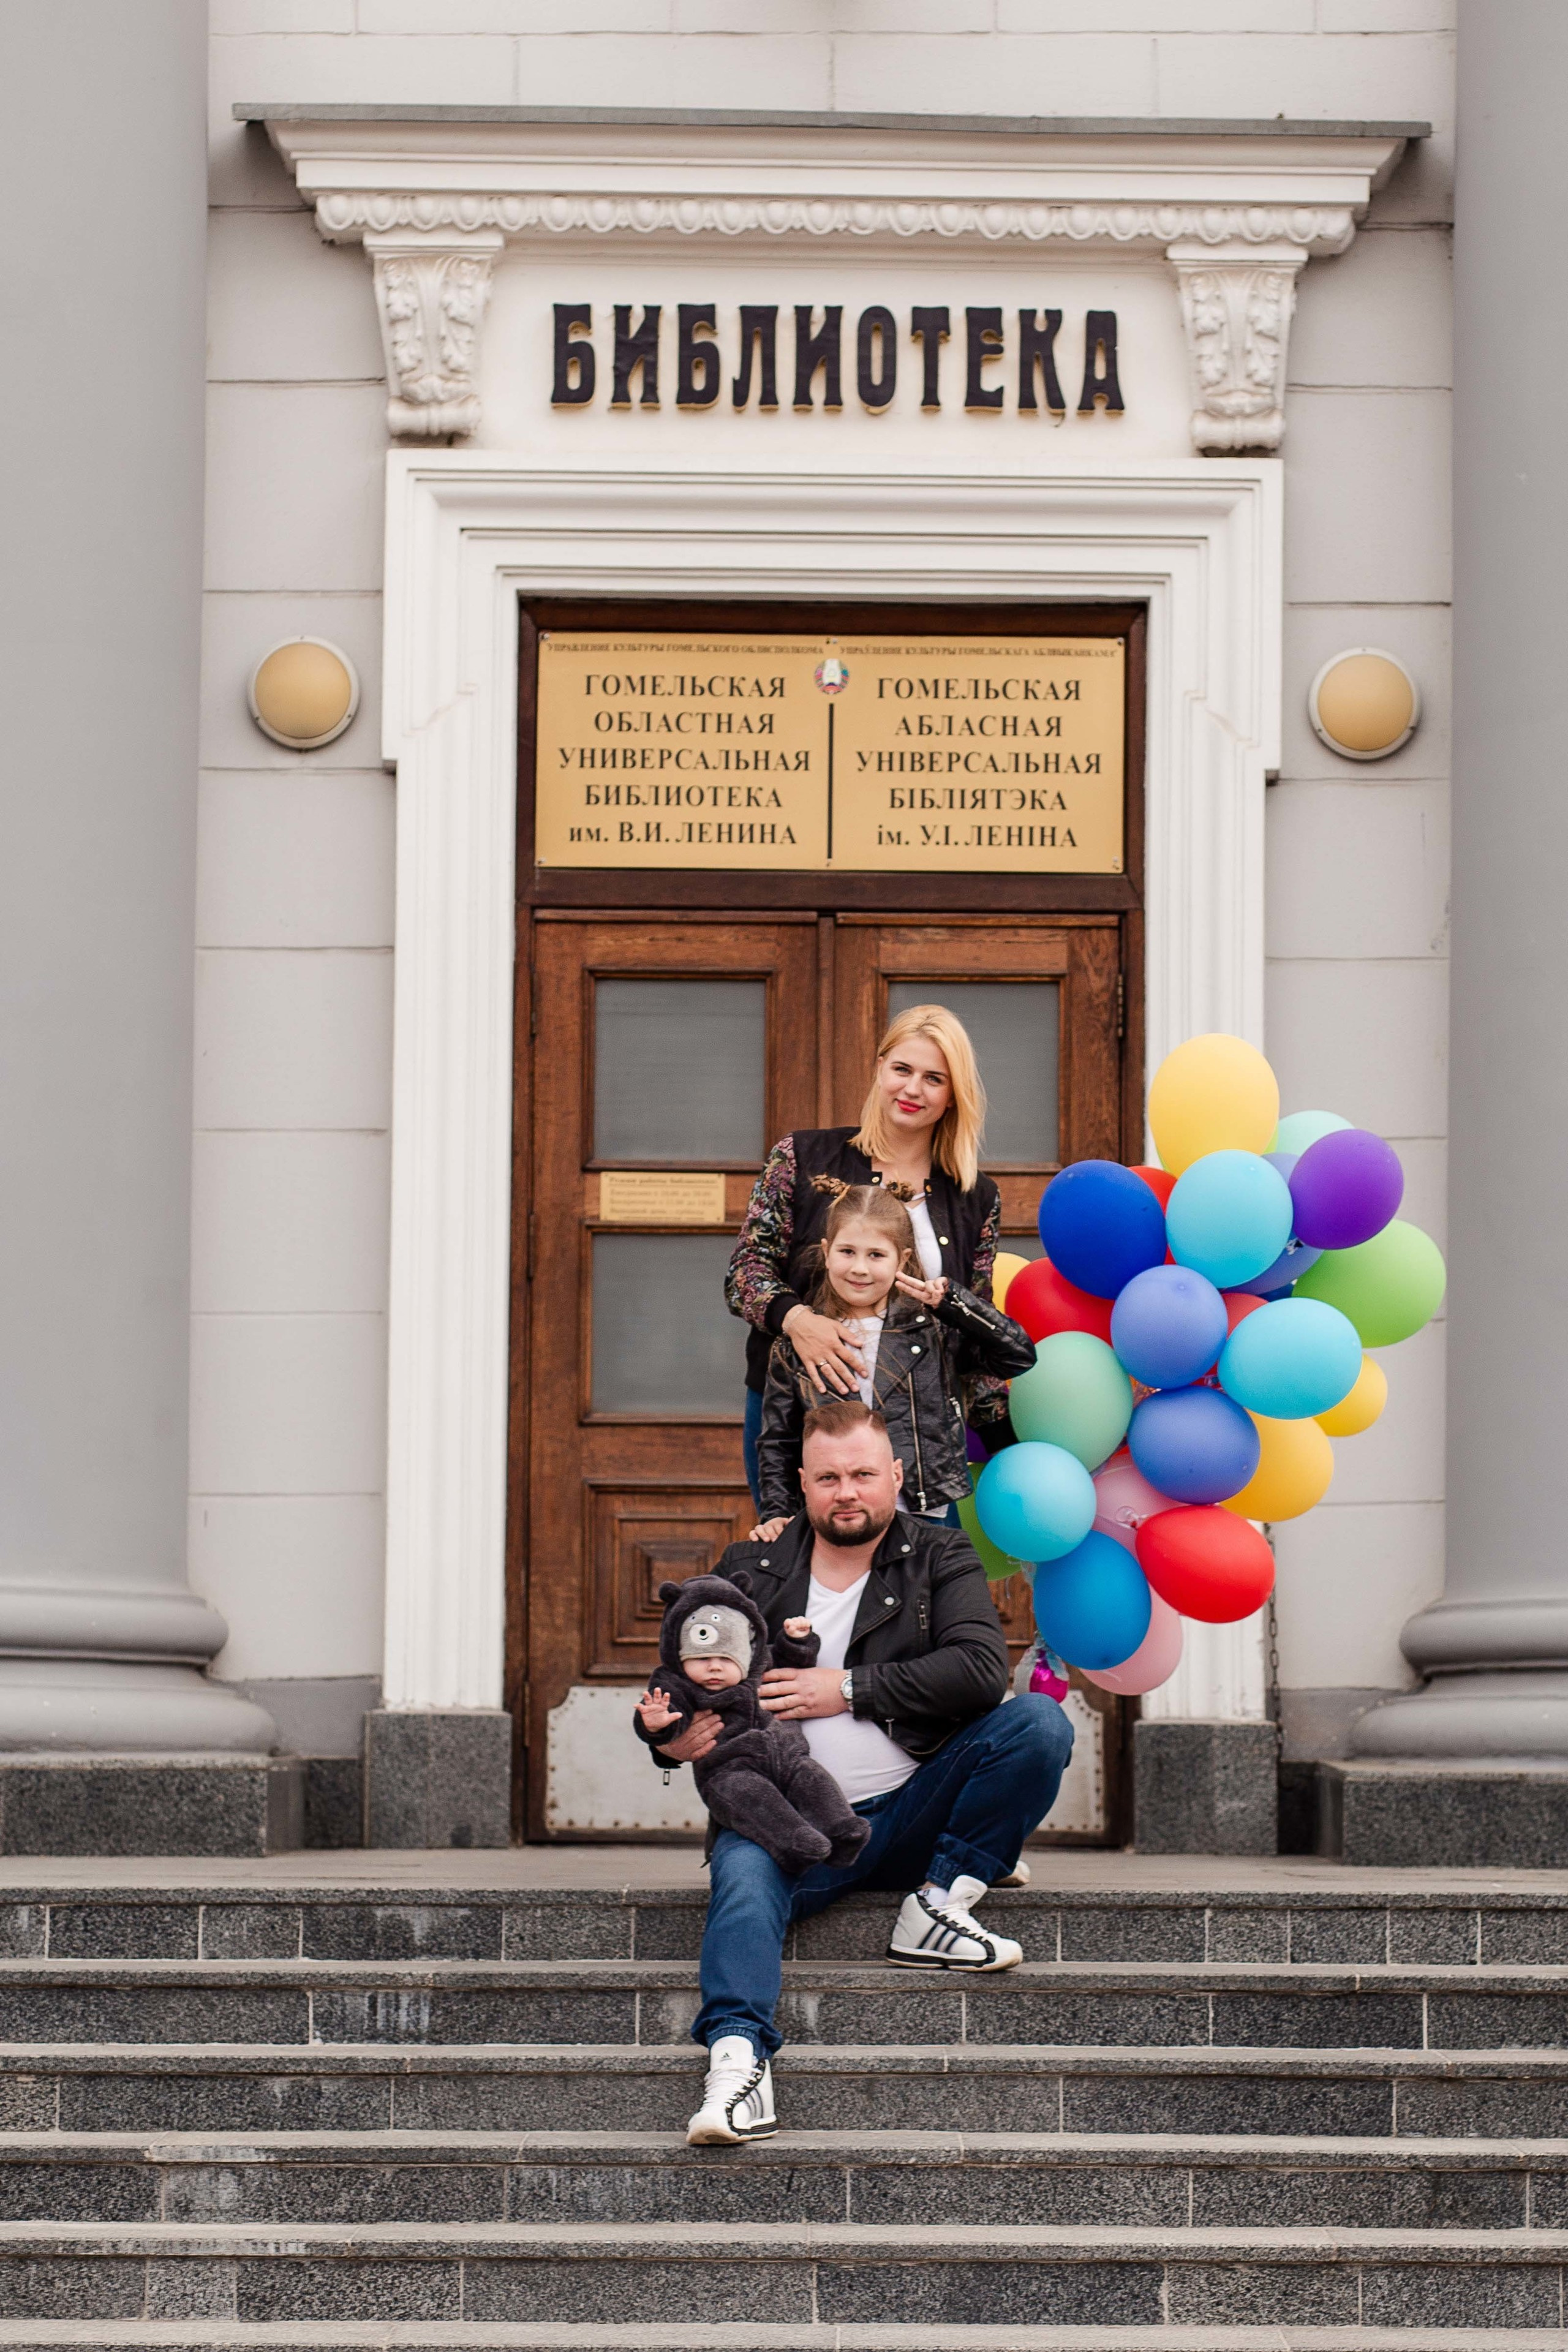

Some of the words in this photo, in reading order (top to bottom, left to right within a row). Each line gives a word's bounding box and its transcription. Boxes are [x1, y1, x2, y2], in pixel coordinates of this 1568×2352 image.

[551, 303, 1126, 414] БИБЛИОТЕКА
[584, 674, 786, 698] ГОМЕЛЬСКАЯ
[877, 677, 1080, 701] ГОМЕЛЬСКАЯ
[594, 711, 775, 734] ОБЛАСТНАЯ
[894, 714, 1062, 737] АБЛАСНАЯ
[559, 747, 810, 771] УНИВЕРСАЛЬНАЯ
[856, 751, 1101, 774] УНІВЕРСАЛЬНАЯ
[584, 784, 783, 808] БИБЛИОТЕКА
[889, 788, 1068, 810] БІБЛІЯТЭКА
[569, 827, 609, 842] им.
[619, 821, 670, 843] В.И.
[675, 822, 797, 845] ЛЕНИНА
[876, 824, 910, 845] ім.
[963, 825, 1078, 848] ЛЕНІНА
